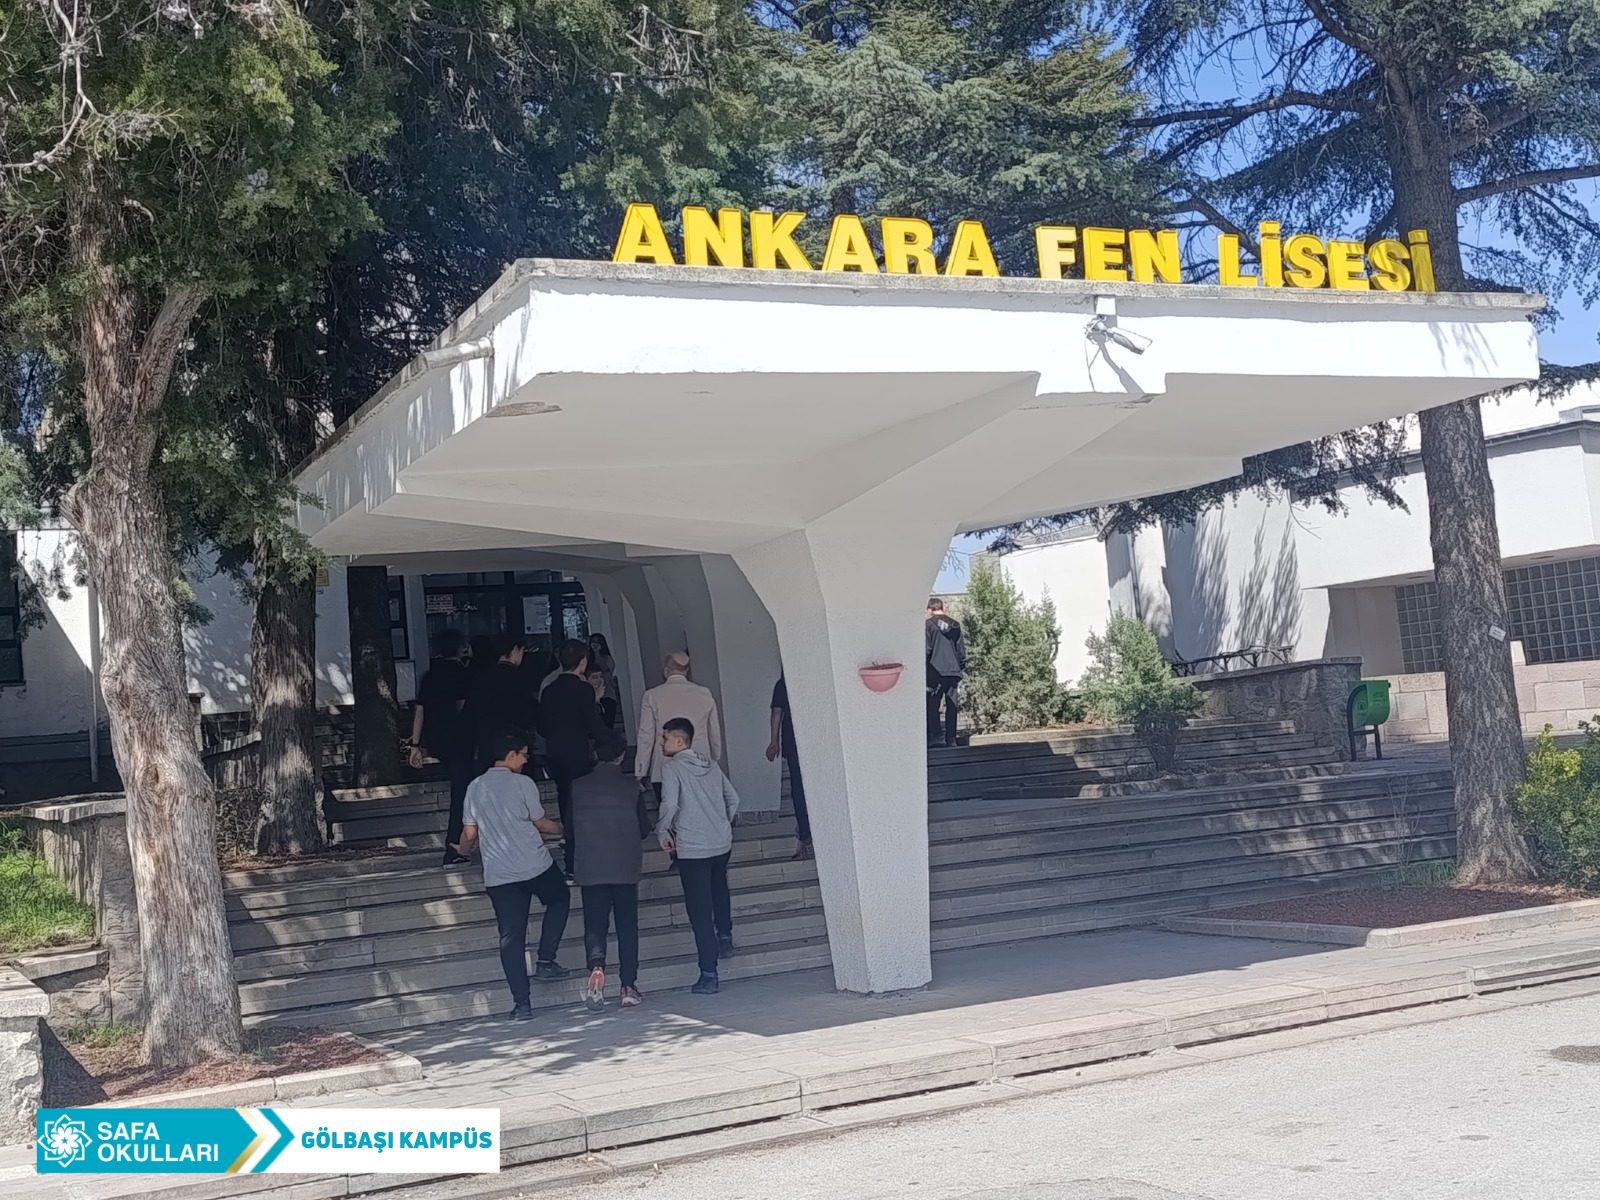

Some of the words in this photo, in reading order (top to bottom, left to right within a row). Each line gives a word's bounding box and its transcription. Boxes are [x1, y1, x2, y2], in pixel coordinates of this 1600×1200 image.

[614, 203, 1000, 276] ANKARA
[1036, 226, 1182, 284] FEN
[1219, 221, 1434, 292] LİSESİ
